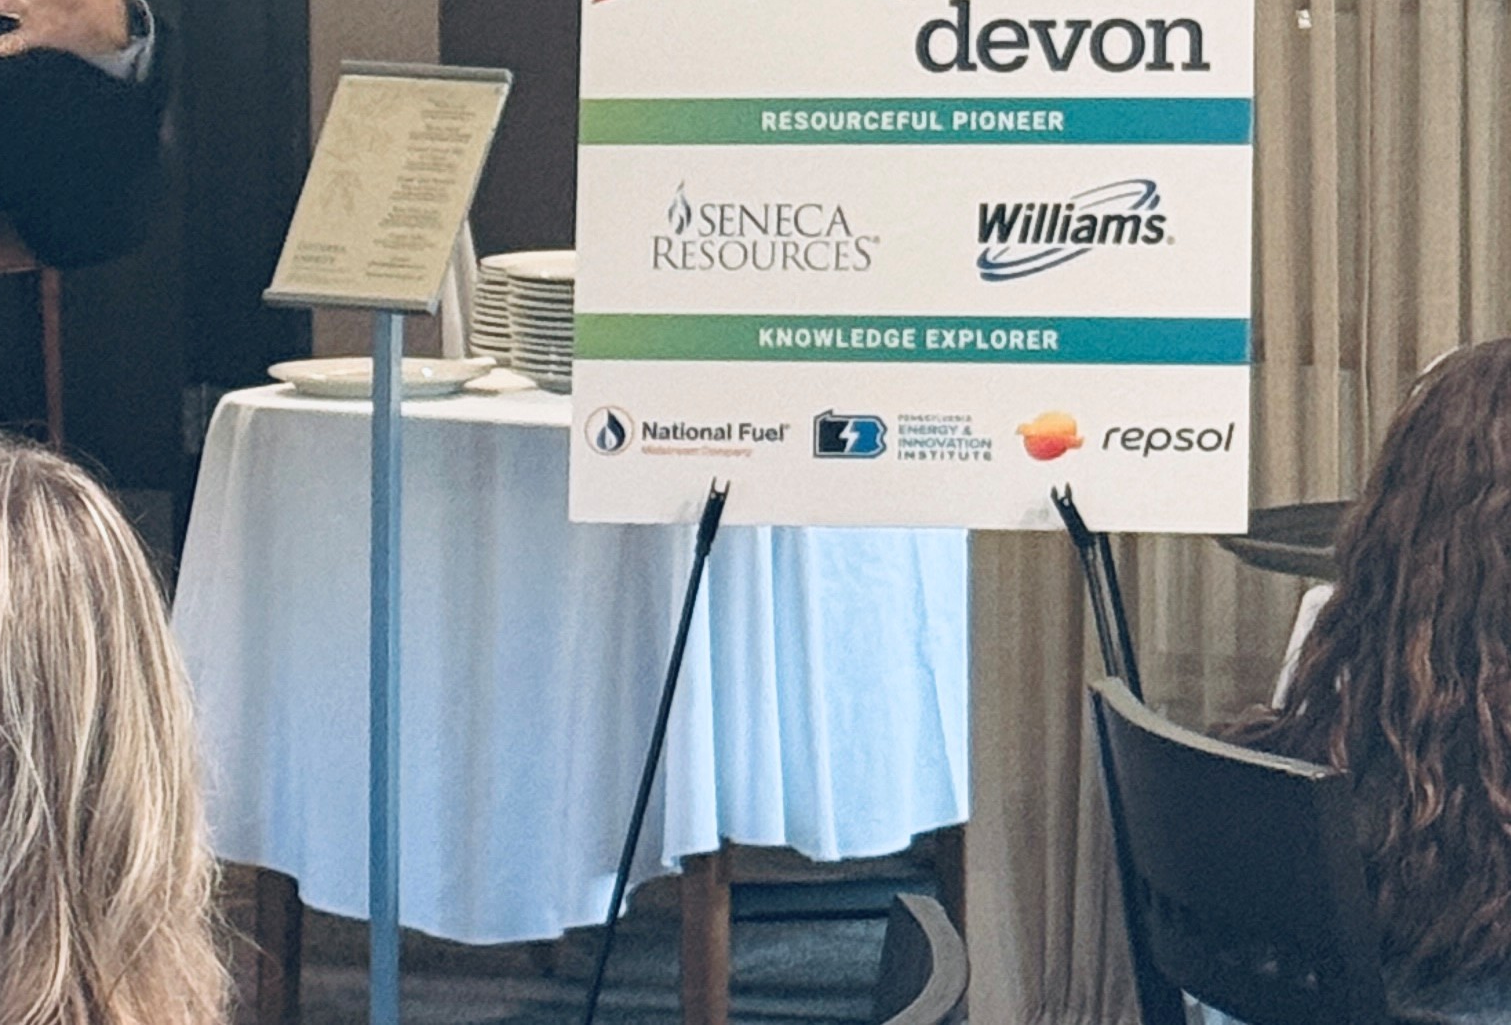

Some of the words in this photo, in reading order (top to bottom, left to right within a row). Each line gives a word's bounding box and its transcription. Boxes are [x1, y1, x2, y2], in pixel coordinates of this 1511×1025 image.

[762, 111, 944, 131] RESOURCEFUL
[953, 111, 1064, 131] PIONEER
[699, 204, 852, 237] SENECA
[978, 201, 1166, 244] Williams
[760, 328, 916, 349] KNOWLEDGE
[926, 329, 1058, 350] EXPLORER
[642, 422, 732, 440] National
[739, 423, 787, 442] Fuel
[897, 425, 958, 435] ENERGY
[1103, 423, 1234, 457] repsol
[897, 437, 992, 449] INNOVATION
[897, 451, 992, 462] INSTITUTE
